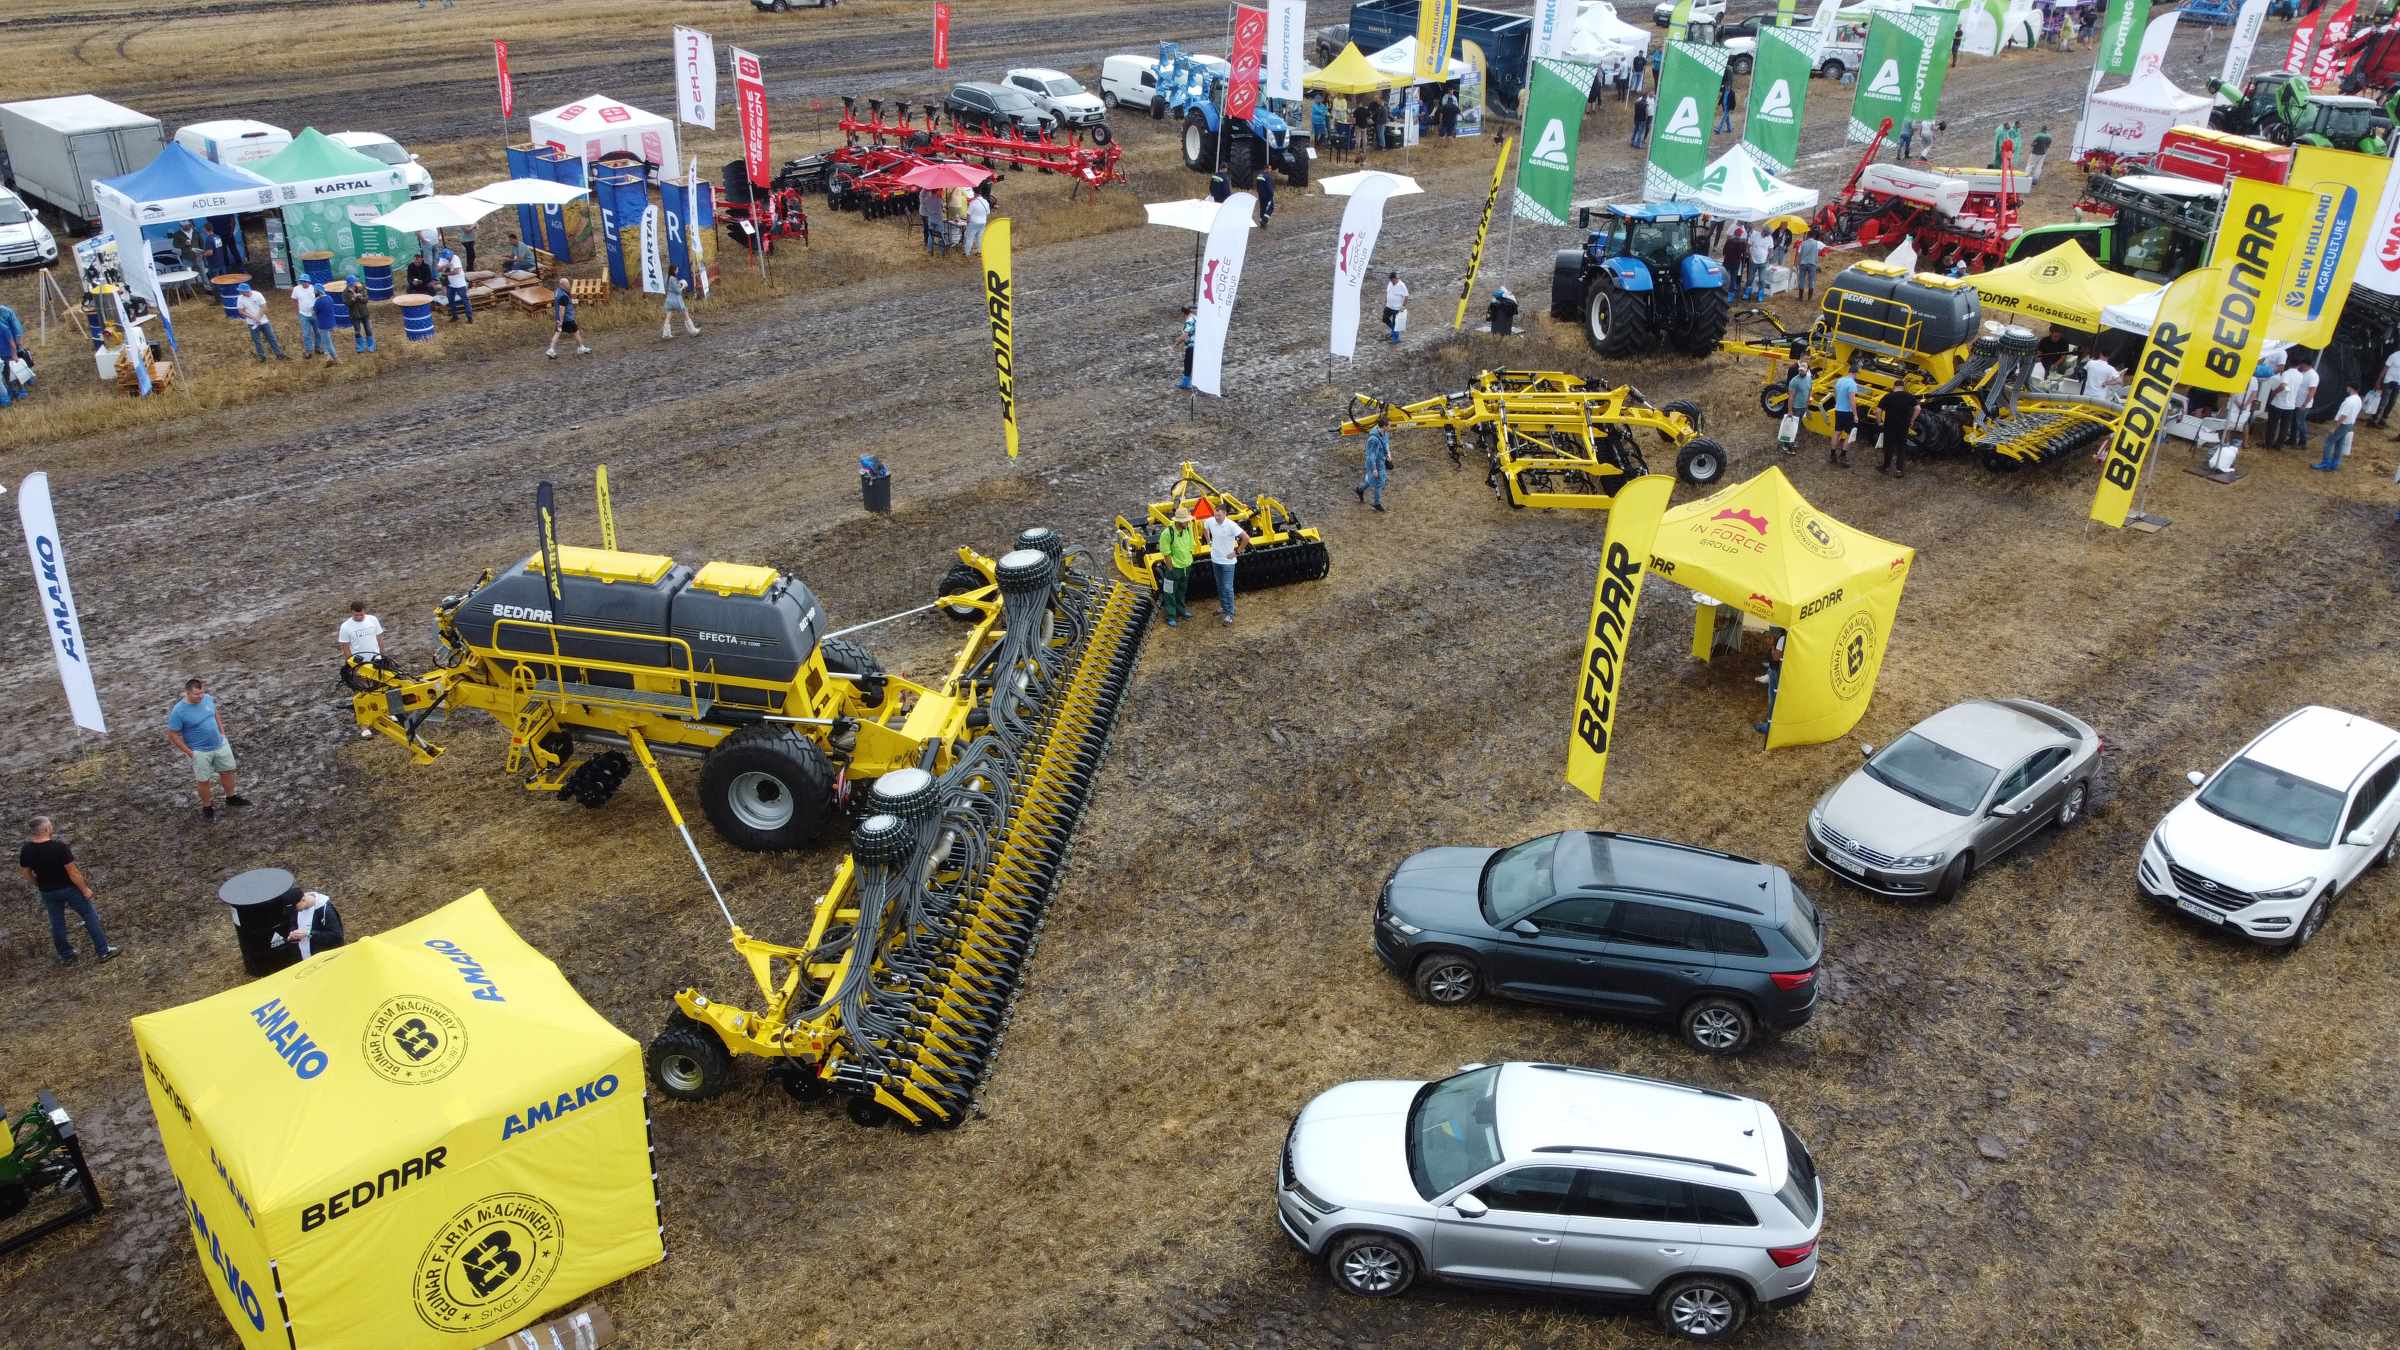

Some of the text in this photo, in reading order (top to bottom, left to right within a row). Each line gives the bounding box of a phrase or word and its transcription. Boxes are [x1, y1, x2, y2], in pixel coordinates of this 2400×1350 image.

[1543, 0, 1556, 41] LEMK
[192, 197, 227, 209] ADLER
[314, 179, 373, 195] KARTAL
[646, 210, 658, 280] KARTAL
[2295, 194, 2333, 288] NEW HOLLAND
[2317, 218, 2347, 293] AGRICULTURE
[1976, 290, 2020, 309] EDNAR
[2205, 202, 2284, 379] BEDNAR
[987, 269, 1014, 424] BEDNAR
[2104, 320, 2193, 491] BEDNAR
[1690, 523, 1769, 554] IN FORCE
[1699, 538, 1739, 554] GROUP
[35, 535, 81, 663] AMAKO
[492, 604, 553, 623] BEDNAR
[1799, 588, 1844, 621] BEDNAR
[699, 631, 738, 645] EFECTA
[1577, 541, 1642, 754] BEDNAR
[424, 938, 506, 1003] AMAKO
[249, 997, 329, 1080] AMAKO
[369, 1000, 457, 1076] BEDNAR FARM MACHINERY
[145, 1050, 193, 1130] BEDNAR
[301, 1073, 619, 1233] BEDNAR AMAKO
[424, 1202, 554, 1321] BEDNAR FARM MACHINERY
[481, 1293, 522, 1320] SINCE
